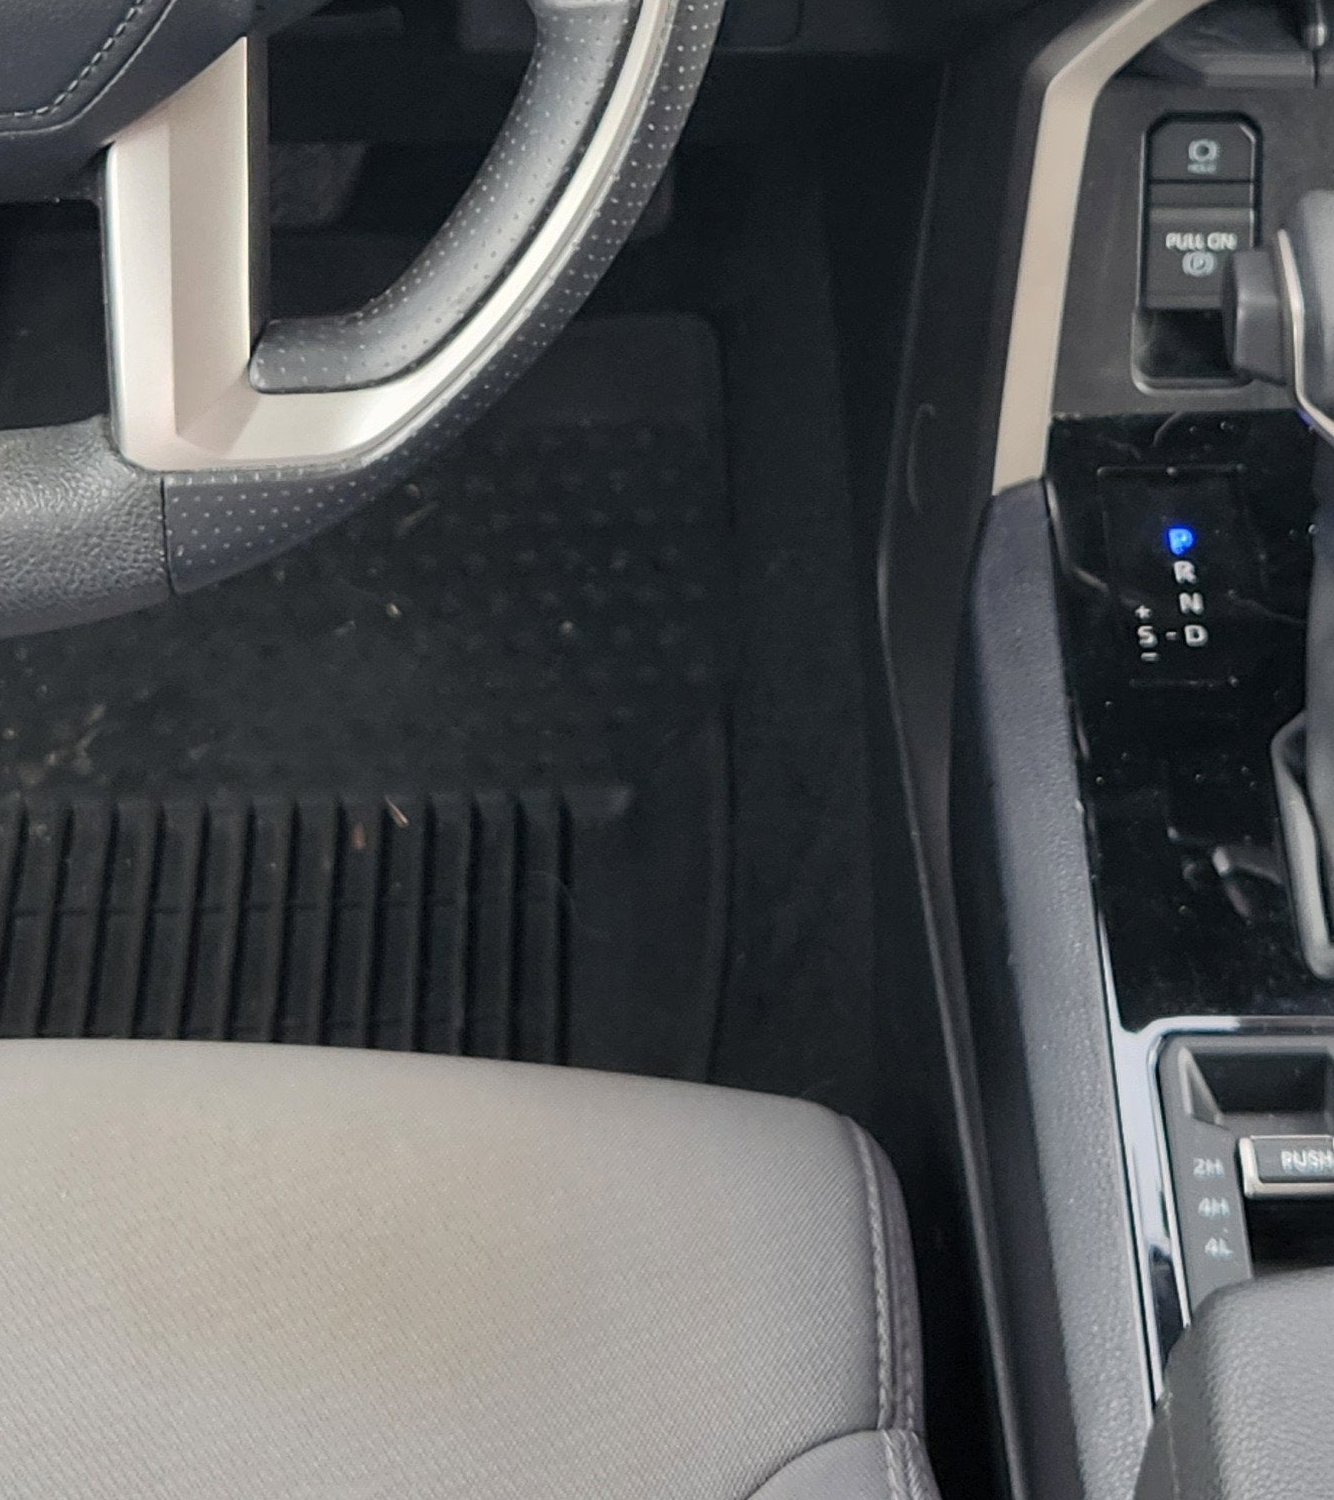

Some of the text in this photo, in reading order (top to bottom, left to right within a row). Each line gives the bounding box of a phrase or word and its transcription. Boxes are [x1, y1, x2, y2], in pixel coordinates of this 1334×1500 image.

[1165, 231, 1238, 251] PULL ON
[1167, 527, 1195, 556] P
[1173, 560, 1198, 585] R
[1178, 591, 1205, 615] N
[1136, 625, 1159, 649] S
[1183, 623, 1209, 648] D
[1192, 1158, 1226, 1177] 2H
[1197, 1197, 1231, 1218] 4H
[1204, 1237, 1235, 1260] 4L
